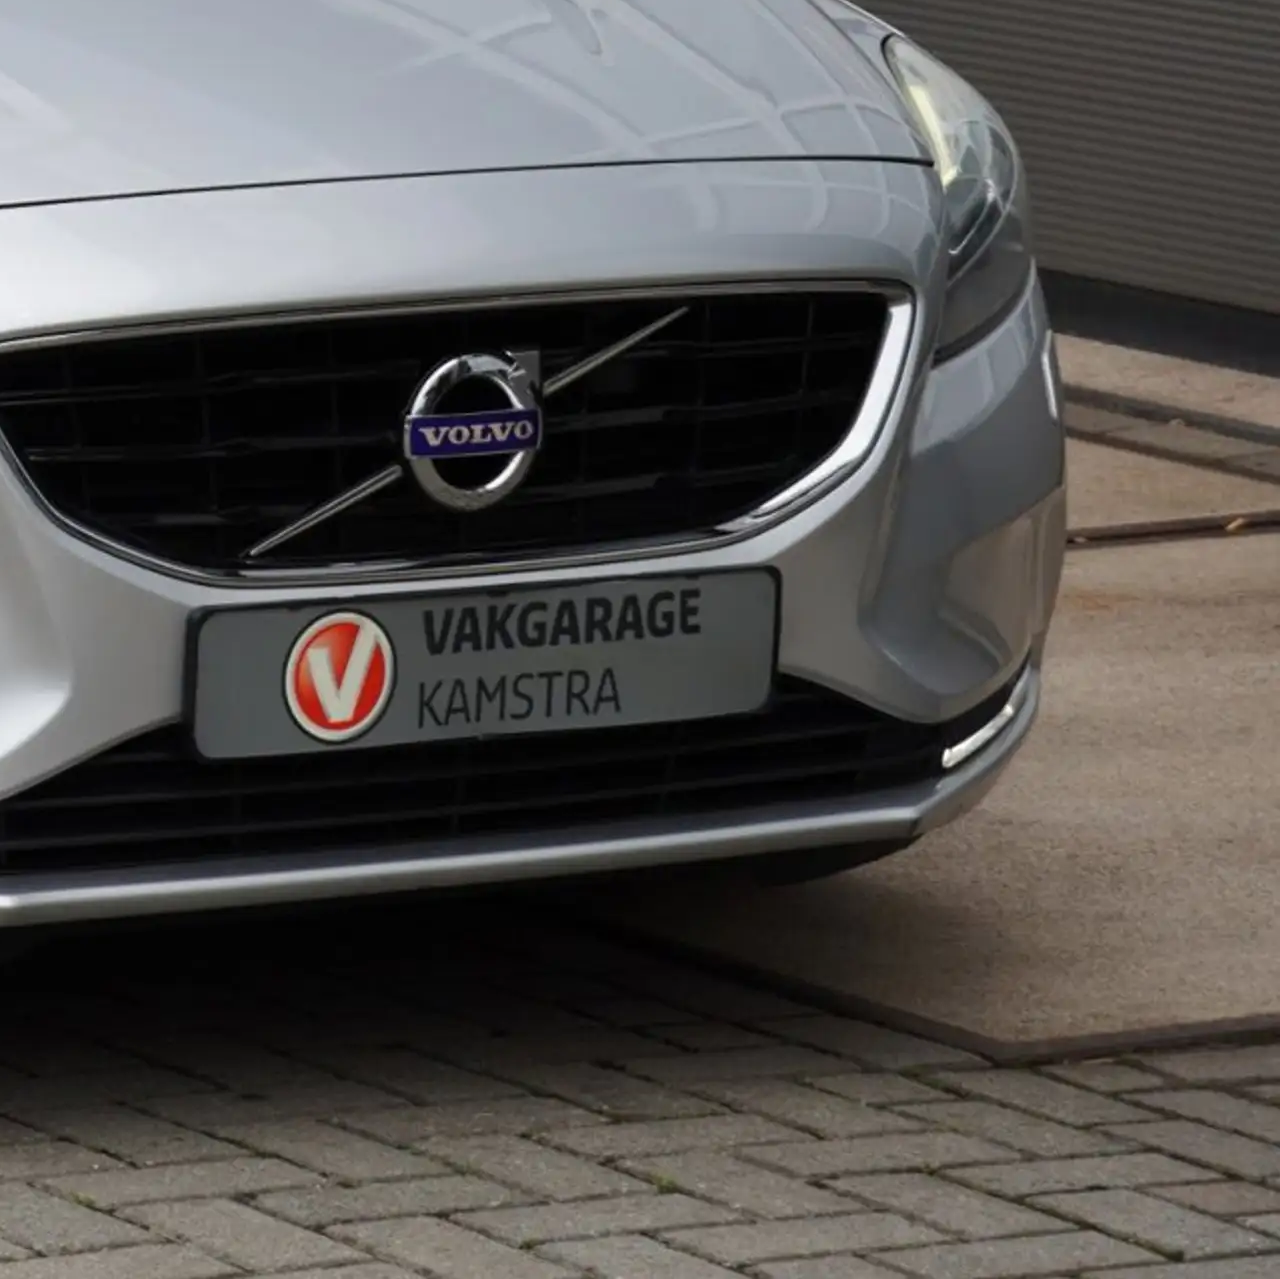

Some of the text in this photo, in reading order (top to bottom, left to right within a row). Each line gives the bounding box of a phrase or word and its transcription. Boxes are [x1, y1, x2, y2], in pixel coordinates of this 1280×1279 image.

[417, 419, 534, 448] VOLVO
[421, 587, 702, 657] VAKGARAGE
[306, 621, 382, 723] V
[417, 666, 622, 730] KAMSTRA
